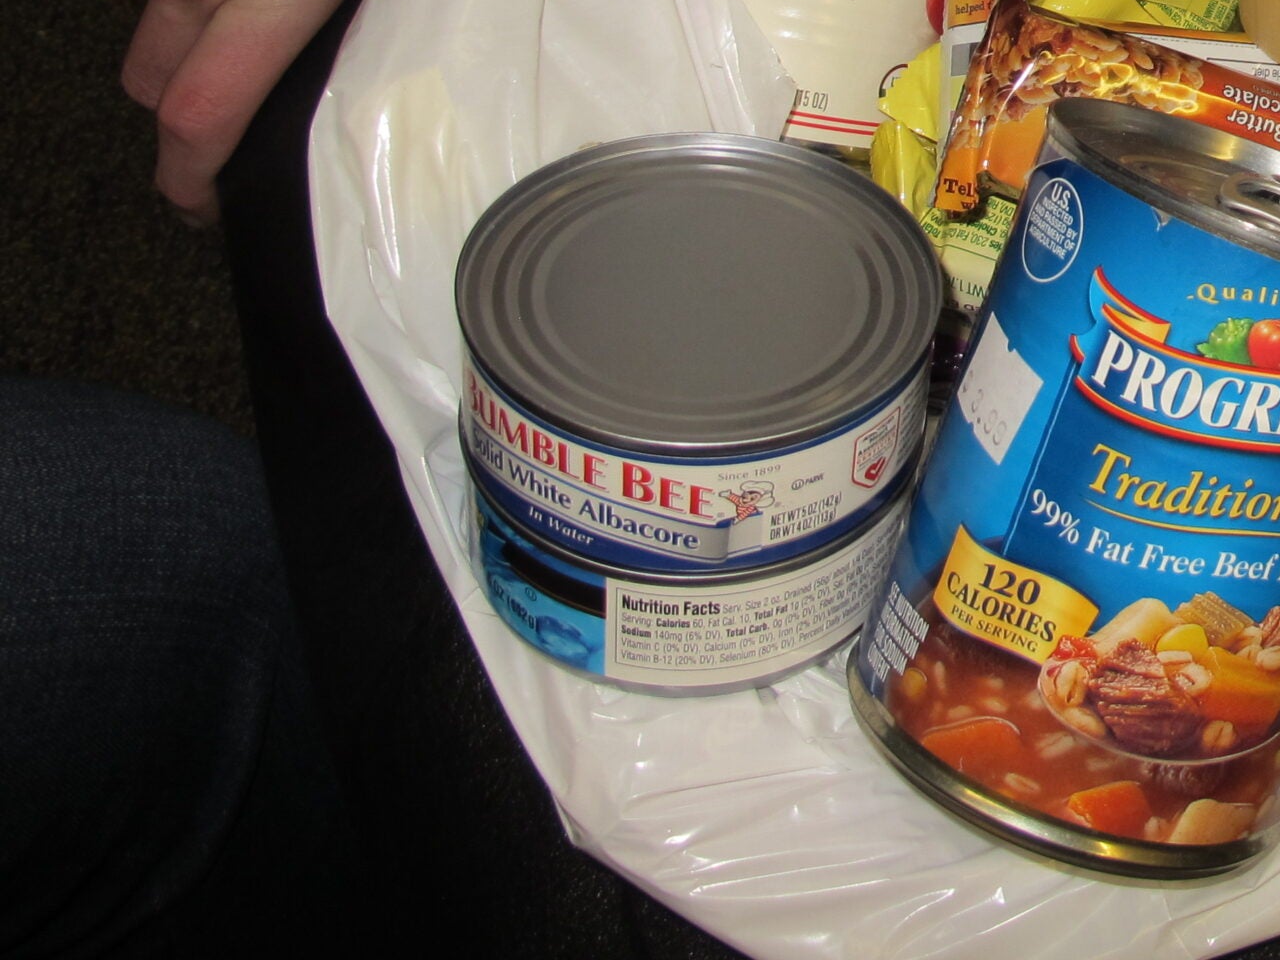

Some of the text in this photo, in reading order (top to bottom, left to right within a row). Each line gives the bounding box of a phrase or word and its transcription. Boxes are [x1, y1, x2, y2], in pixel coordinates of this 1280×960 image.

[955, 2, 985, 16] helped
[1051, 182, 1071, 212] U.S.
[1042, 196, 1074, 226] INSPECTED
[1064, 239, 1075, 252] OF
[1066, 228, 1078, 240] BY
[718, 464, 782, 482] Since 1899
[804, 473, 825, 486] PARVE
[474, 428, 699, 550] Solid White Albacore
[622, 462, 716, 519] BEE
[771, 491, 842, 527] NET WT 5 OZ (142g)
[530, 507, 594, 545] In Water
[770, 527, 782, 540] DR
[782, 524, 796, 538] WT
[803, 518, 813, 531] OZ
[1032, 489, 1080, 545] 99%
[1086, 530, 1136, 568] Fat
[1140, 545, 1206, 576] Free
[1213, 552, 1280, 583] Beef
[978, 563, 1041, 606] 120
[622, 595, 681, 615] Nutrition
[684, 601, 721, 617] Facts
[745, 598, 761, 610] Size
[656, 604, 788, 629] Calories Fat Total Fat
[947, 571, 1057, 642] CALORIES
[621, 621, 770, 642] Sodium 140mg Total Carb.
[951, 605, 1038, 653] PER SERVING
[621, 638, 737, 652] Vitamin Calcium
[621, 649, 757, 664] Vitamin Selenium
